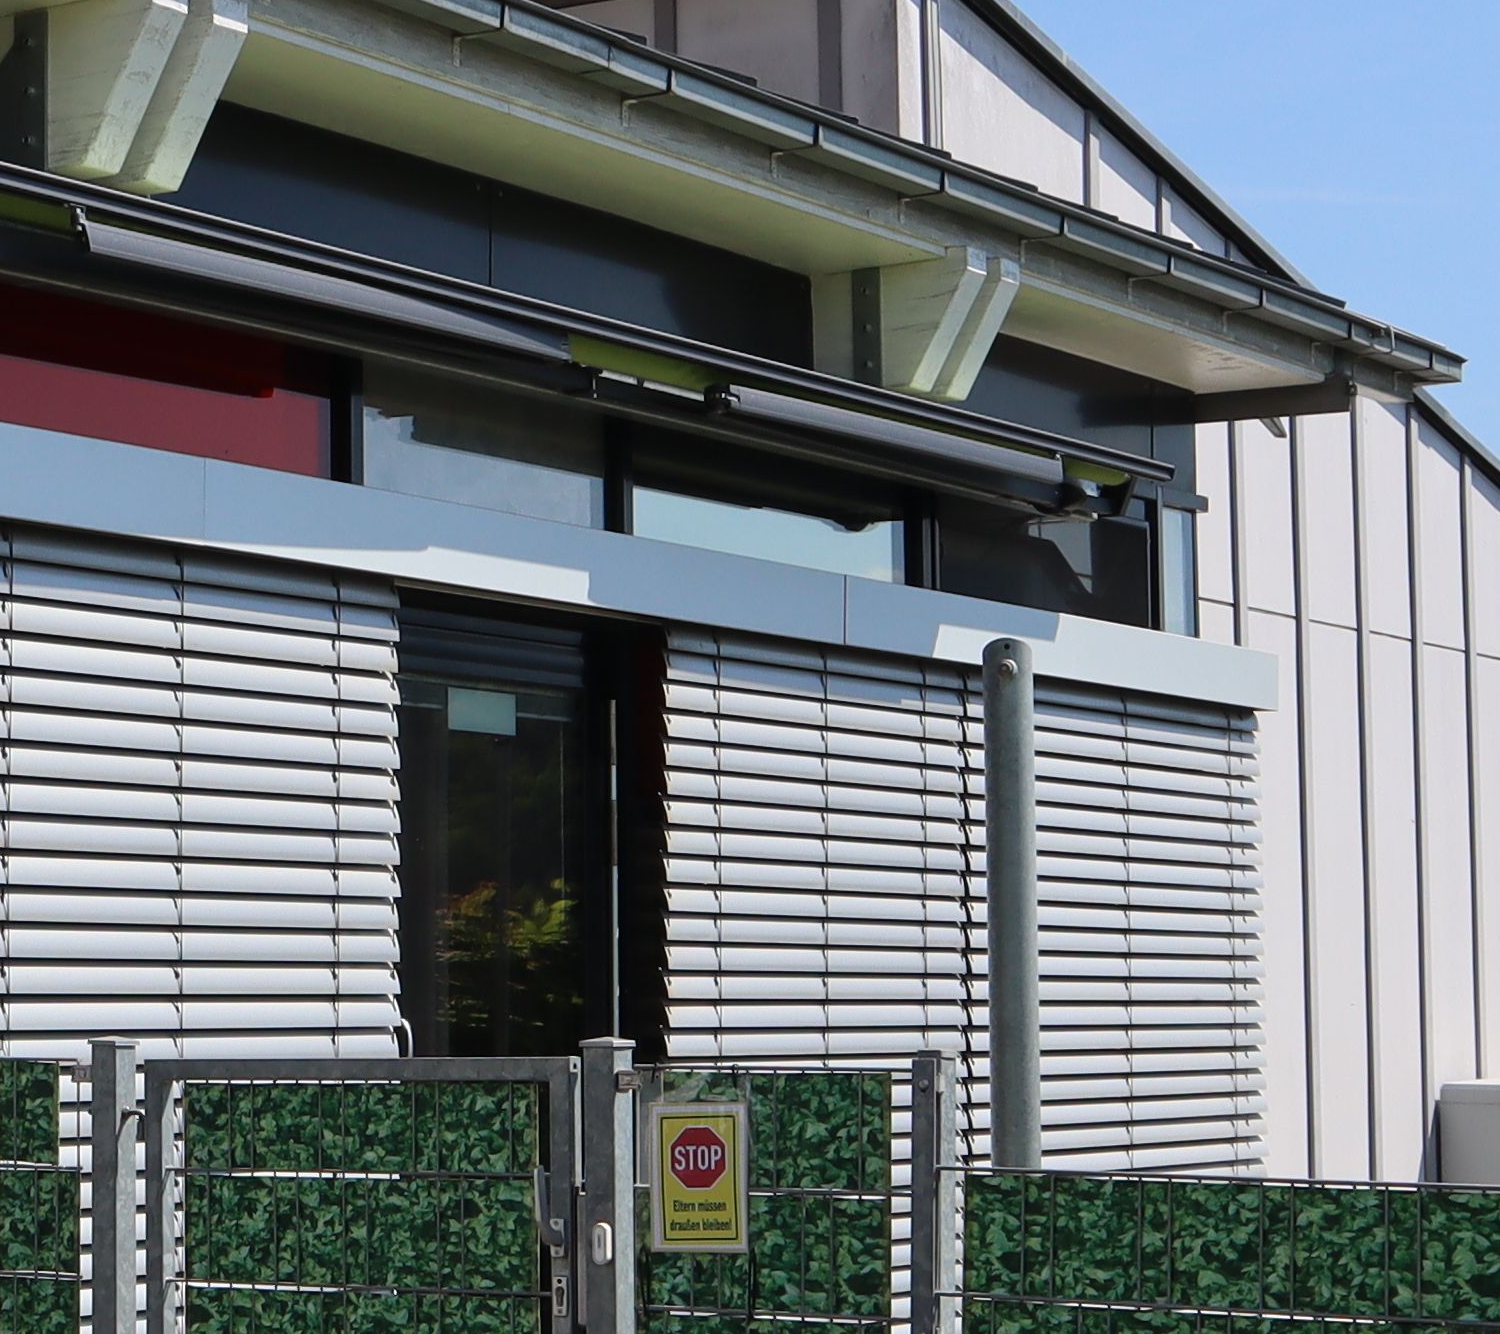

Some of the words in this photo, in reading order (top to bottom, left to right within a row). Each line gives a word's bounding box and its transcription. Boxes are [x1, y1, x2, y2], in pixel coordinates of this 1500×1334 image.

[674, 1145, 722, 1170] STOP
[673, 1200, 696, 1212] Eltern
[698, 1199, 727, 1212] müssen
[670, 1219, 700, 1231] draußen
[702, 1218, 732, 1231] bleiben!
